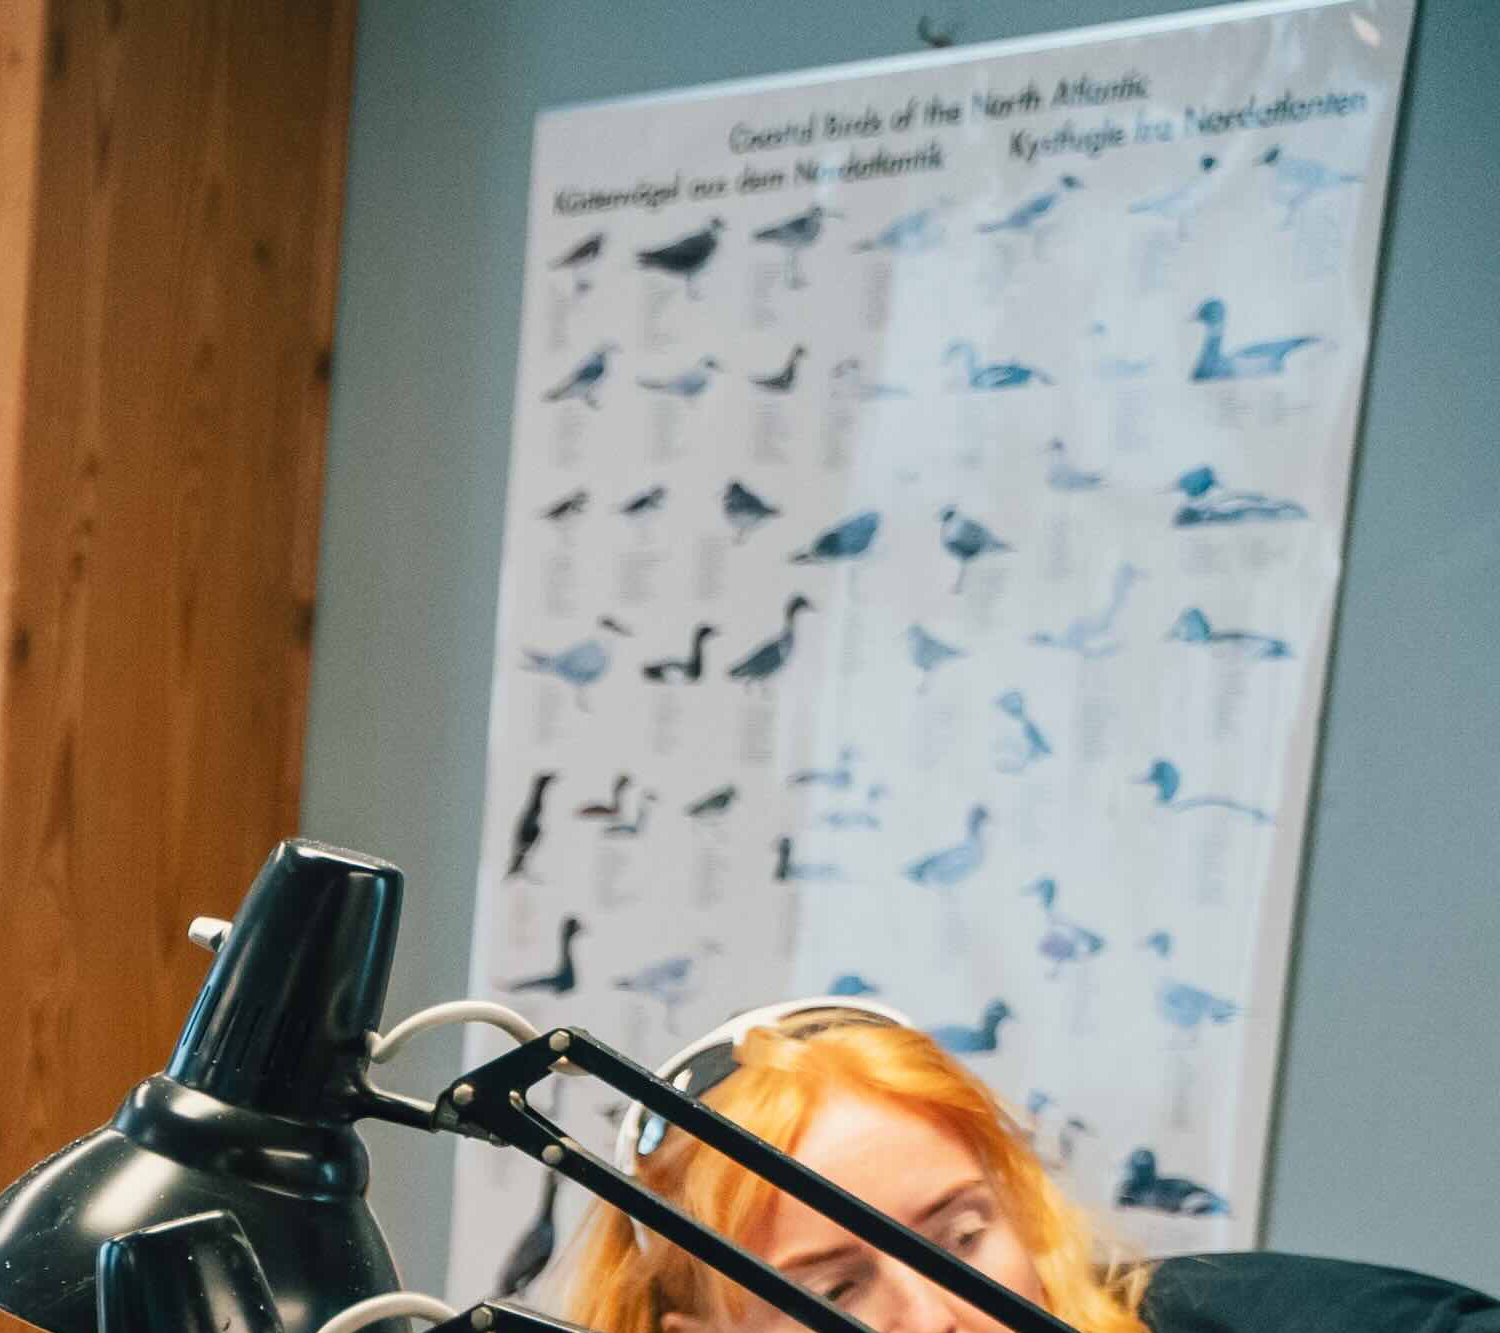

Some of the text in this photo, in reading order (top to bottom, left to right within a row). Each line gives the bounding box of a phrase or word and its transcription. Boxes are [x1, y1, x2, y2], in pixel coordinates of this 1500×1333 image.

[822, 104, 883, 138] Birds
[891, 99, 916, 130] of
[924, 93, 962, 126] the
[971, 81, 1040, 119] North
